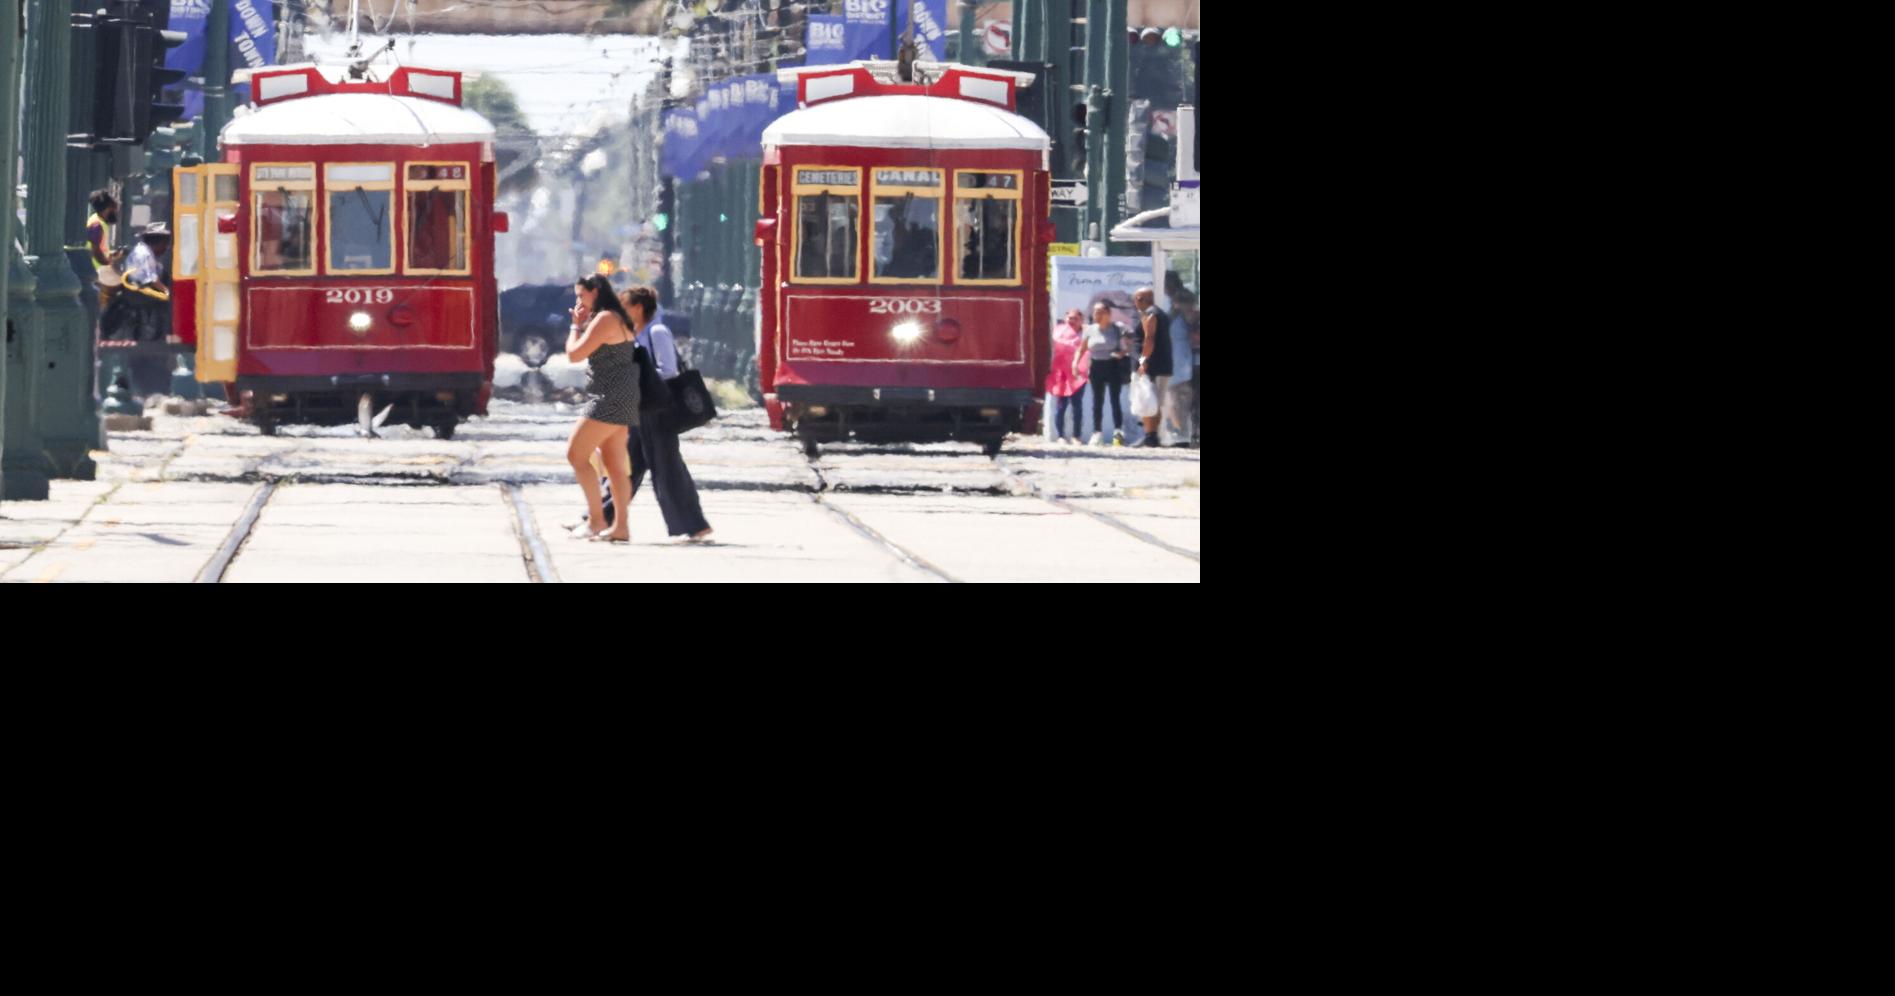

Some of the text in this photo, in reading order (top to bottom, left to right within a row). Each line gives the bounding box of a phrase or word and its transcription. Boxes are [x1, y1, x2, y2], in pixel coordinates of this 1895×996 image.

[235, 0, 268, 38] DOWN
[877, 171, 940, 182] CANAL
[326, 288, 394, 304] 2019
[869, 300, 942, 313] 2003
